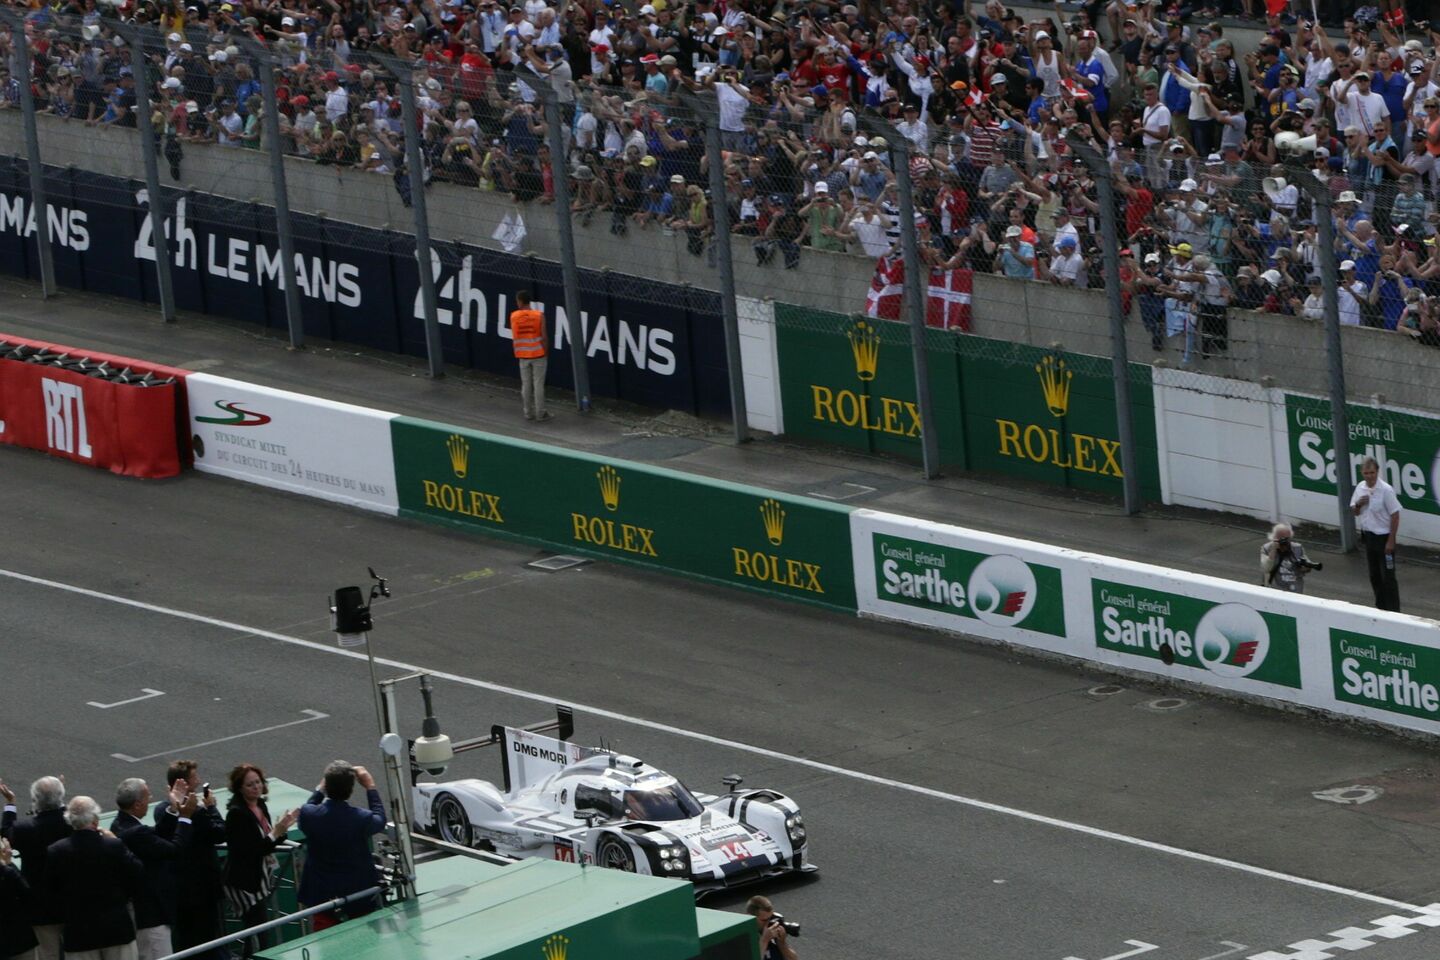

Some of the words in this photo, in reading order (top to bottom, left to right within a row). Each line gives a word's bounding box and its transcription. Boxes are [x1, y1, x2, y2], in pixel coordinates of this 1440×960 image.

[208, 233, 250, 283] LE
[41, 377, 93, 459] RTL
[810, 385, 923, 440] ROLEX
[214, 431, 256, 451] SYNDICAT
[259, 441, 288, 457] MIXTE
[996, 419, 1123, 479] ROLEX
[216, 450, 230, 462] DU
[232, 454, 268, 471] CIRCUIT
[271, 462, 288, 475] DES
[288, 459, 304, 479] 24
[305, 469, 342, 488] HEURES
[343, 477, 357, 490] DU
[359, 481, 386, 497] MANS
[423, 479, 504, 524] ROLEX
[571, 513, 658, 558] ROLEX
[880, 542, 913, 563] Conseil
[914, 550, 946, 569] général
[731, 547, 825, 594] ROLEX
[881, 559, 967, 608] Sarthe
[1100, 588, 1136, 610] Conseil
[1136, 596, 1172, 617] général
[1102, 606, 1193, 658] Sarthe
[1339, 638, 1378, 662] Conseil
[1379, 647, 1417, 670] général
[1341, 657, 1440, 713] Sarthe
[513, 741, 538, 757] DMG
[539, 748, 568, 766] MORI
[720, 841, 753, 862] 14
